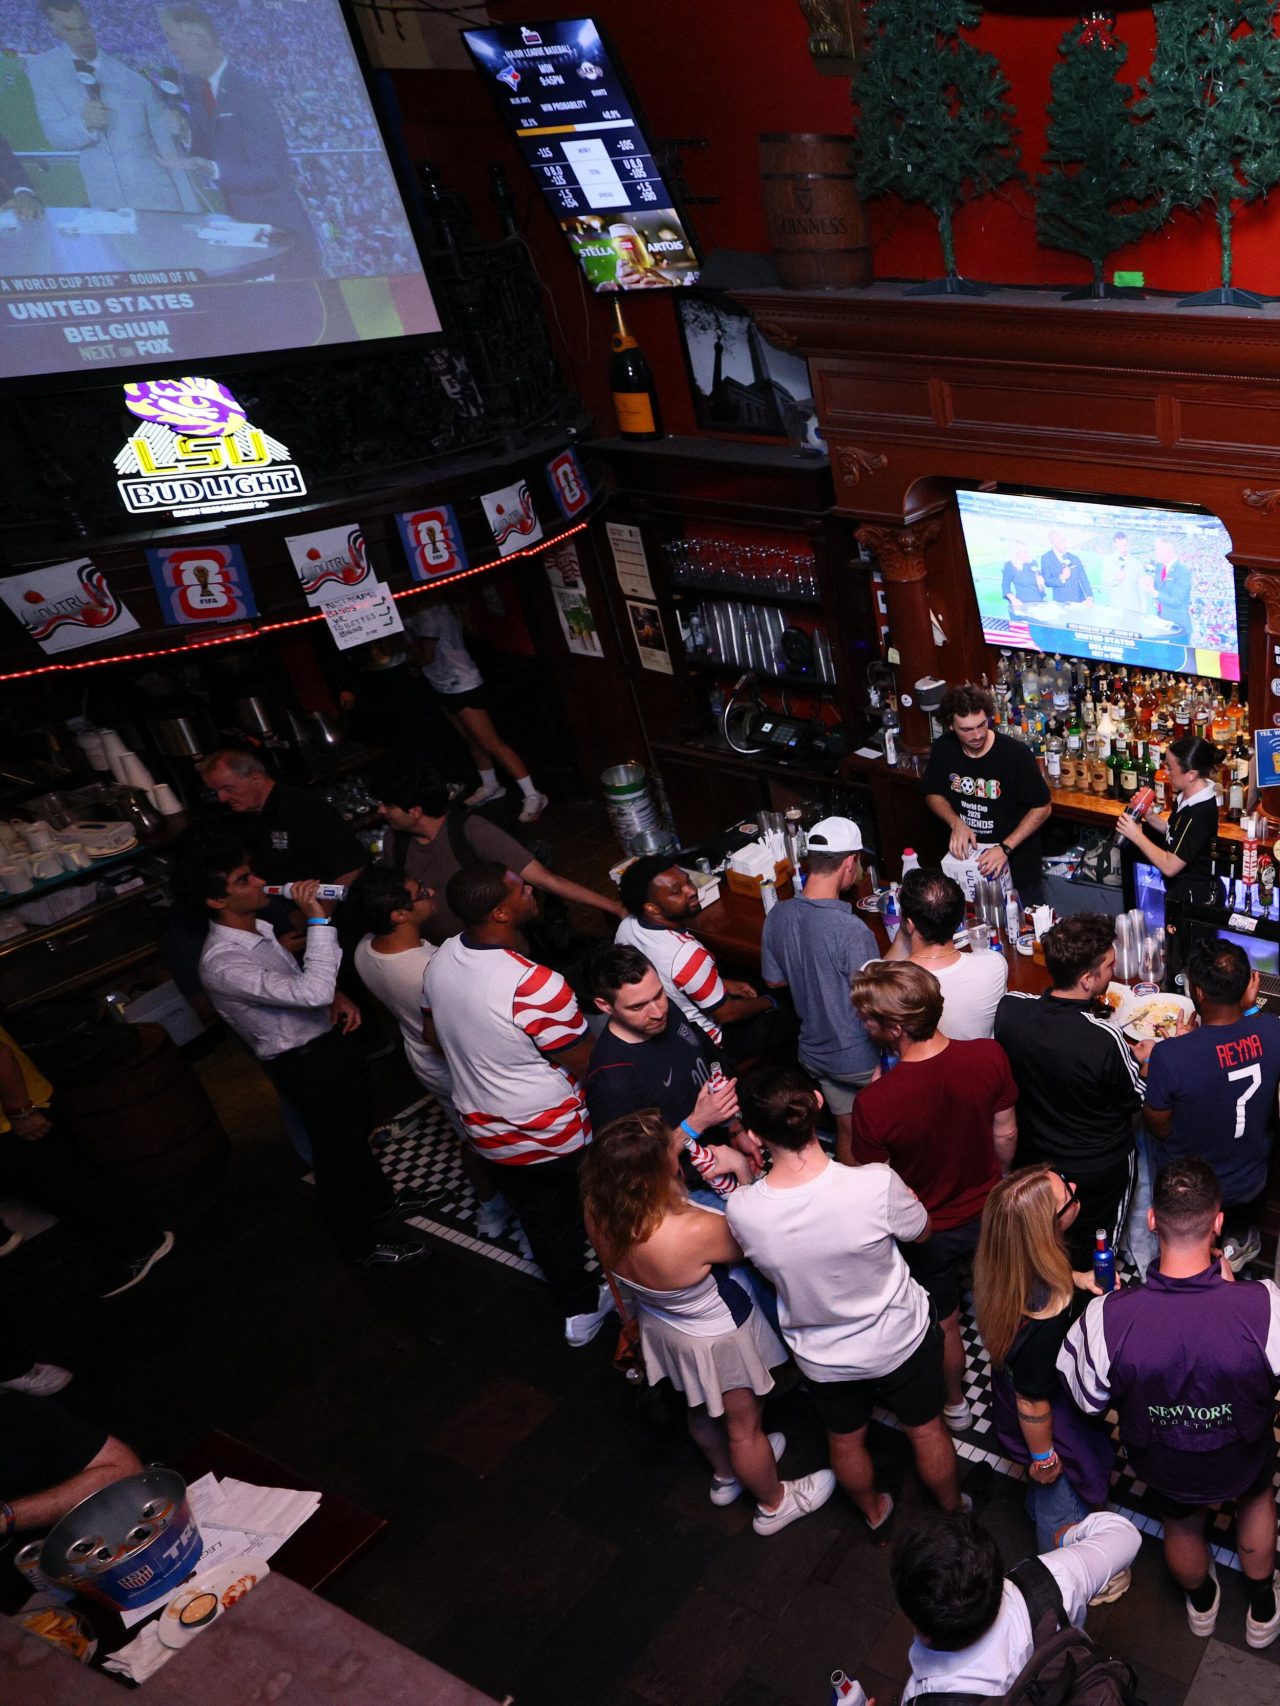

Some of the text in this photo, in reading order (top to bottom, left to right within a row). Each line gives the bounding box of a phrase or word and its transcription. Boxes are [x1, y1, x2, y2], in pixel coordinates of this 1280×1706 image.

[504, 45, 572, 59] MAJOR LEAGUE BASEBALL
[552, 99, 587, 112] PROBABILITY
[537, 147, 553, 158] -115
[616, 140, 635, 151] -105
[623, 158, 643, 169] U 8.0
[774, 215, 848, 235] GUINNESS
[579, 246, 615, 257] STELLA
[648, 240, 684, 252] ARTOIS
[14, 274, 57, 291] WORLD
[61, 275, 81, 289] CUP
[130, 271, 168, 285] ROUND
[170, 271, 182, 283] OF
[184, 271, 197, 282] 16
[8, 293, 194, 320] UNITED STATES
[63, 320, 170, 343] BELGIUM
[80, 344, 117, 361] NEXT
[136, 338, 175, 355] FOX
[128, 429, 272, 476] LSU
[126, 470, 300, 508] BUD LIGHT
[200, 596, 219, 605] FIFA
[960, 799, 988, 813] World Cup
[967, 810, 981, 819] 2026
[1215, 1034, 1262, 1069] REYNA
[1228, 1063, 1262, 1139] 7
[1148, 1403, 1233, 1421] NEW YORK
[1150, 1416, 1233, 1430] TOGETHER
